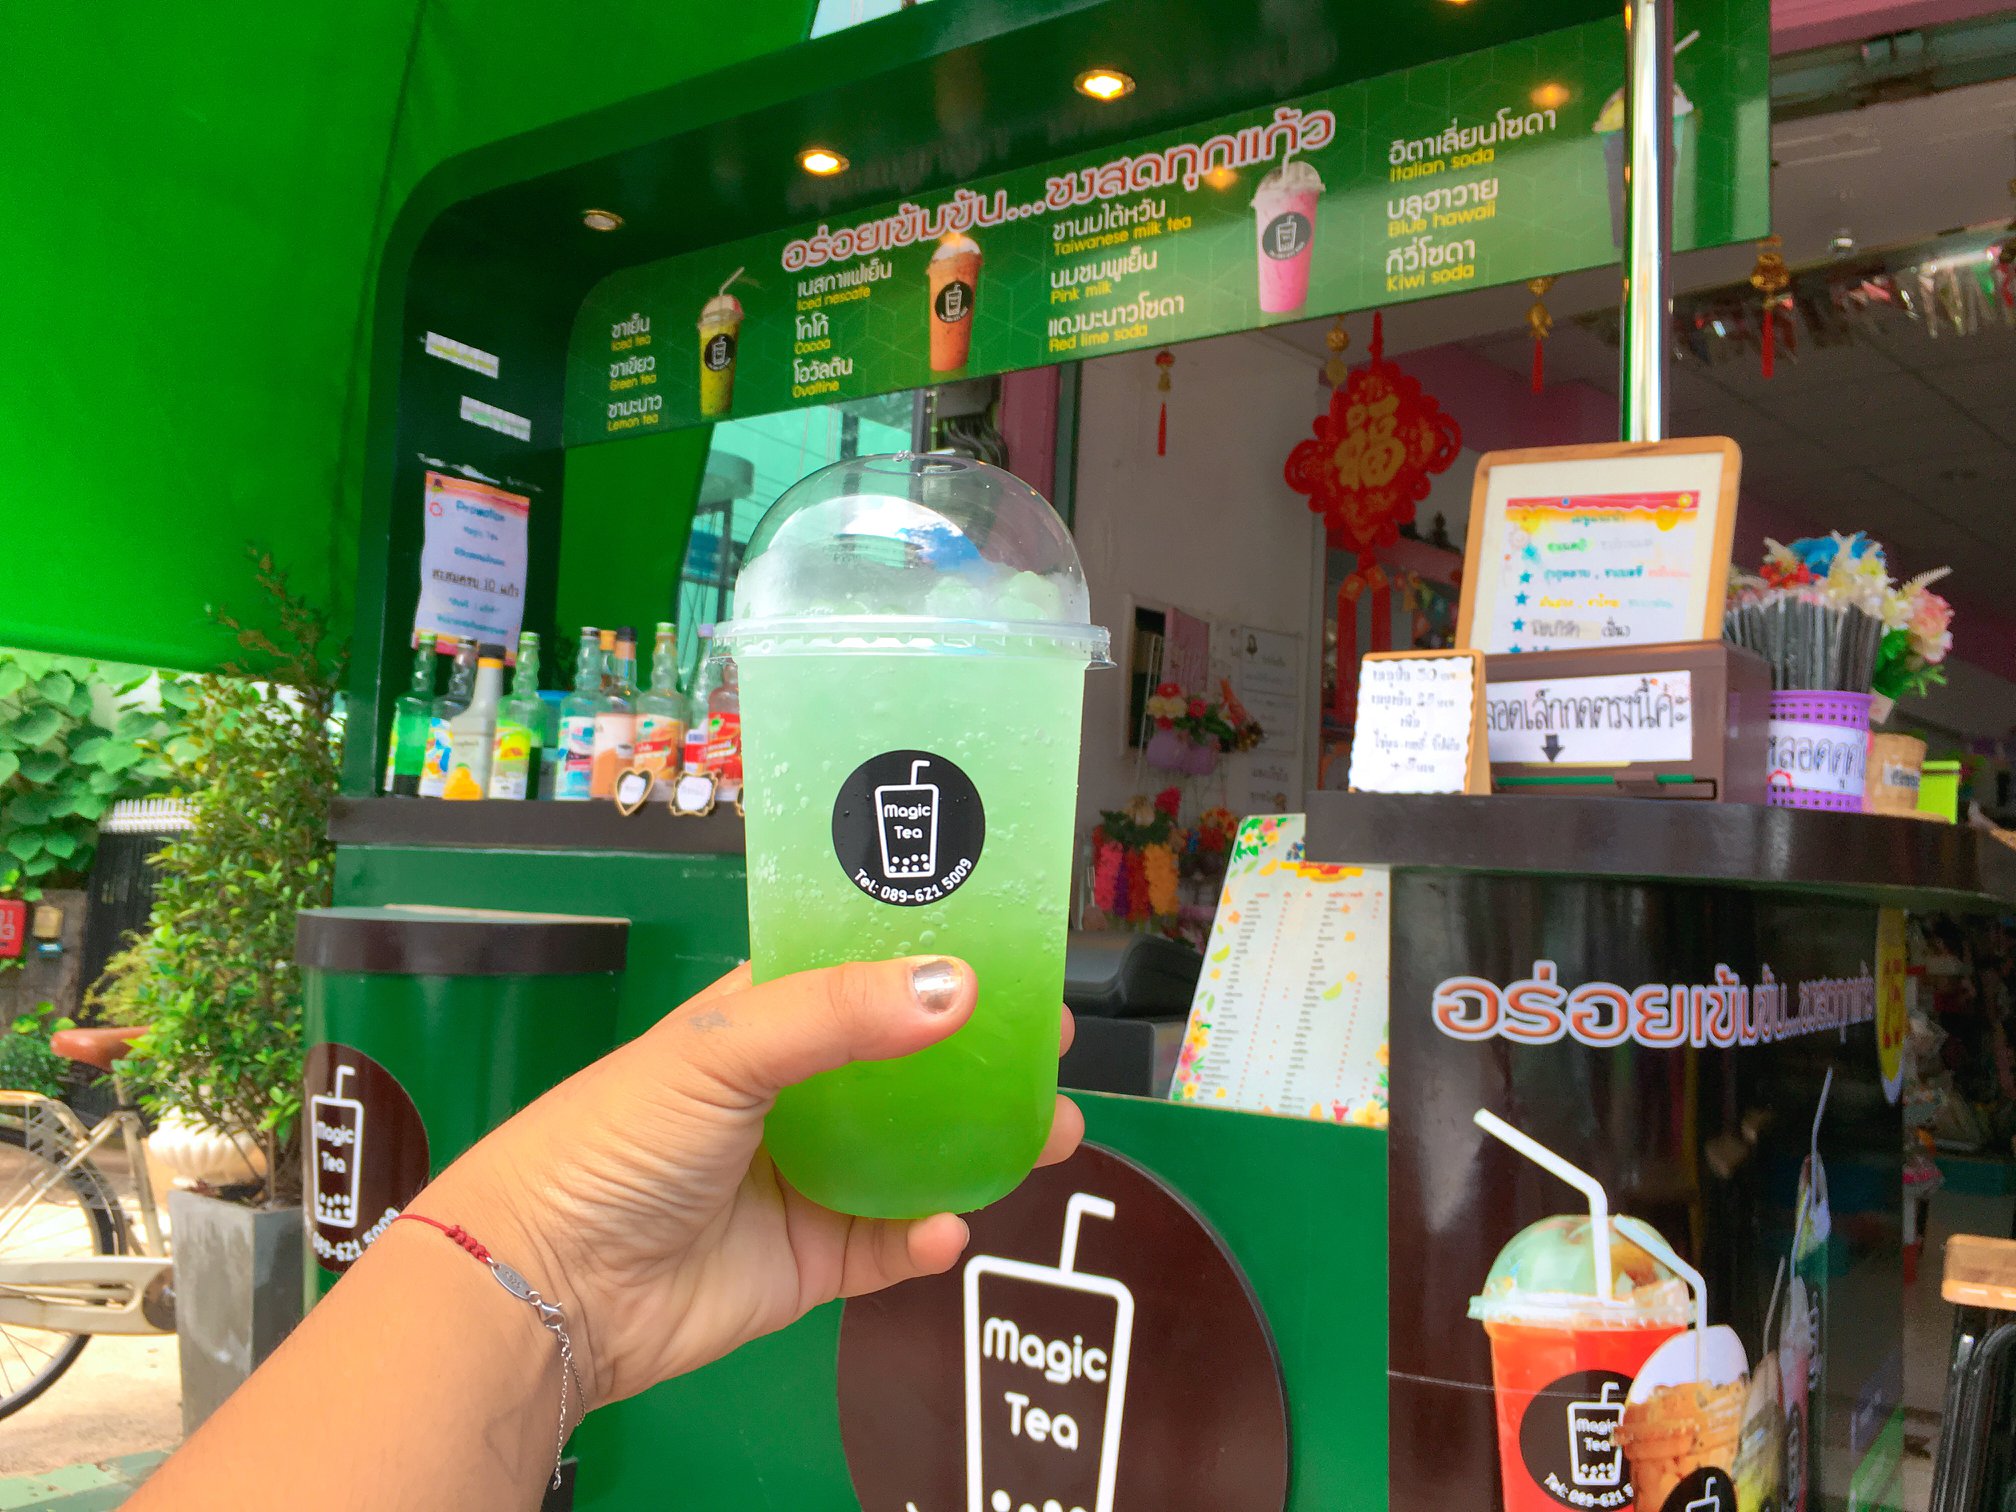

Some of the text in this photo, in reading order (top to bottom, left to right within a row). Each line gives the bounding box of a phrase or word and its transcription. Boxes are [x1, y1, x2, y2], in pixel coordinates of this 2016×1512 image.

[1389, 107, 1556, 165] อิตาเลี่ยนโซดา
[1390, 148, 1495, 182] Italian soda
[1388, 178, 1498, 221] บลูฮาวาย
[1052, 199, 1166, 241] ชานมไต้หวัน
[1054, 216, 1192, 256] Taiwanese milk tea
[1388, 200, 1496, 238] Blue hawaii
[797, 257, 893, 297] เนสกาแฟเย็น
[1051, 246, 1158, 289] นมชมพูเย็น
[1386, 263, 1475, 292] Kiwi soda
[1050, 280, 1112, 305] Pink milk
[611, 313, 651, 339] ชาเย็น
[795, 311, 829, 340] โกโก้
[1048, 290, 1184, 337] แดงมะนาวโซดา
[794, 338, 831, 355] Cocoa
[1049, 323, 1148, 353] Red lime soda
[610, 356, 656, 378] ชาเขียว
[793, 357, 853, 384] โอวัลติน
[608, 395, 662, 418] ชามะนาว
[1487, 677, 1689, 731] ลอดเล็กกดตรงนี้ค่ะ
[884, 803, 931, 820] Magic
[894, 825, 923, 839] Tea
[854, 858, 973, 903] Tel: 089-621 5009
[983, 1317, 1108, 1384] Magic
[1004, 1391, 1079, 1451] Tea
[1583, 1437, 1610, 1452] Tea
